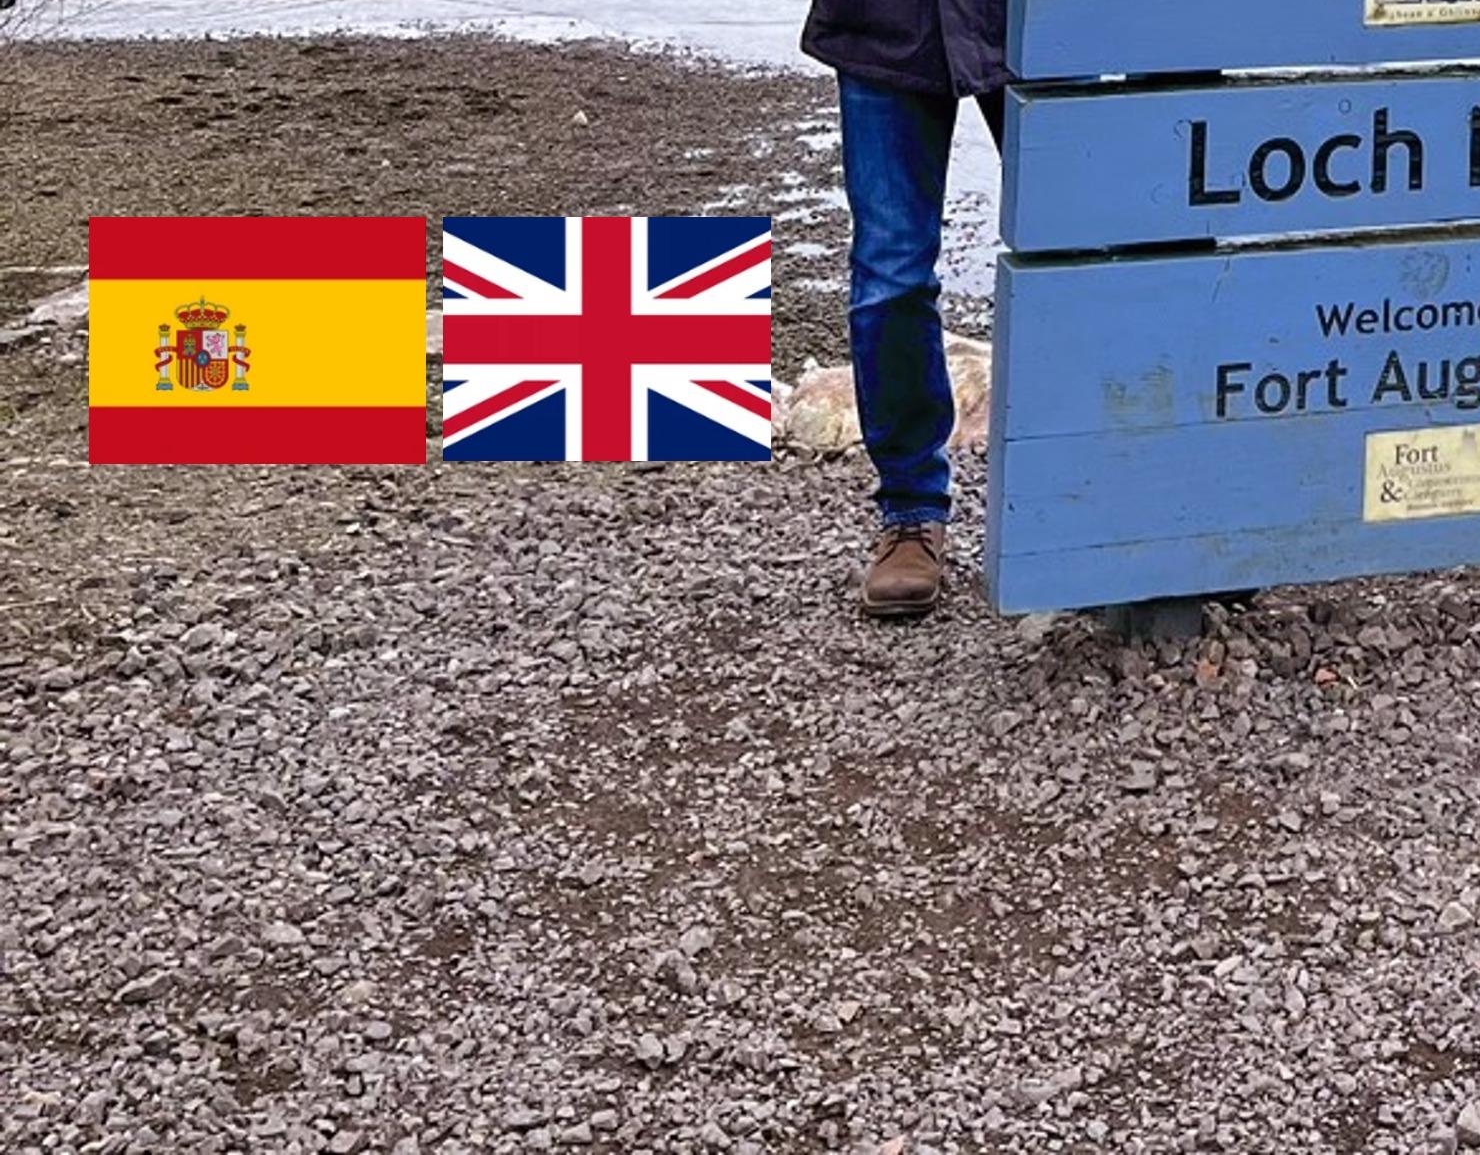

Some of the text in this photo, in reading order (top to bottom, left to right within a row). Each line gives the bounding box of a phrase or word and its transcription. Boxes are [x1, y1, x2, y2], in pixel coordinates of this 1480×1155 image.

[1188, 107, 1423, 206] Loch
[1216, 358, 1348, 418] Fort
[1394, 443, 1439, 465] Fort
[1380, 479, 1403, 504] &
